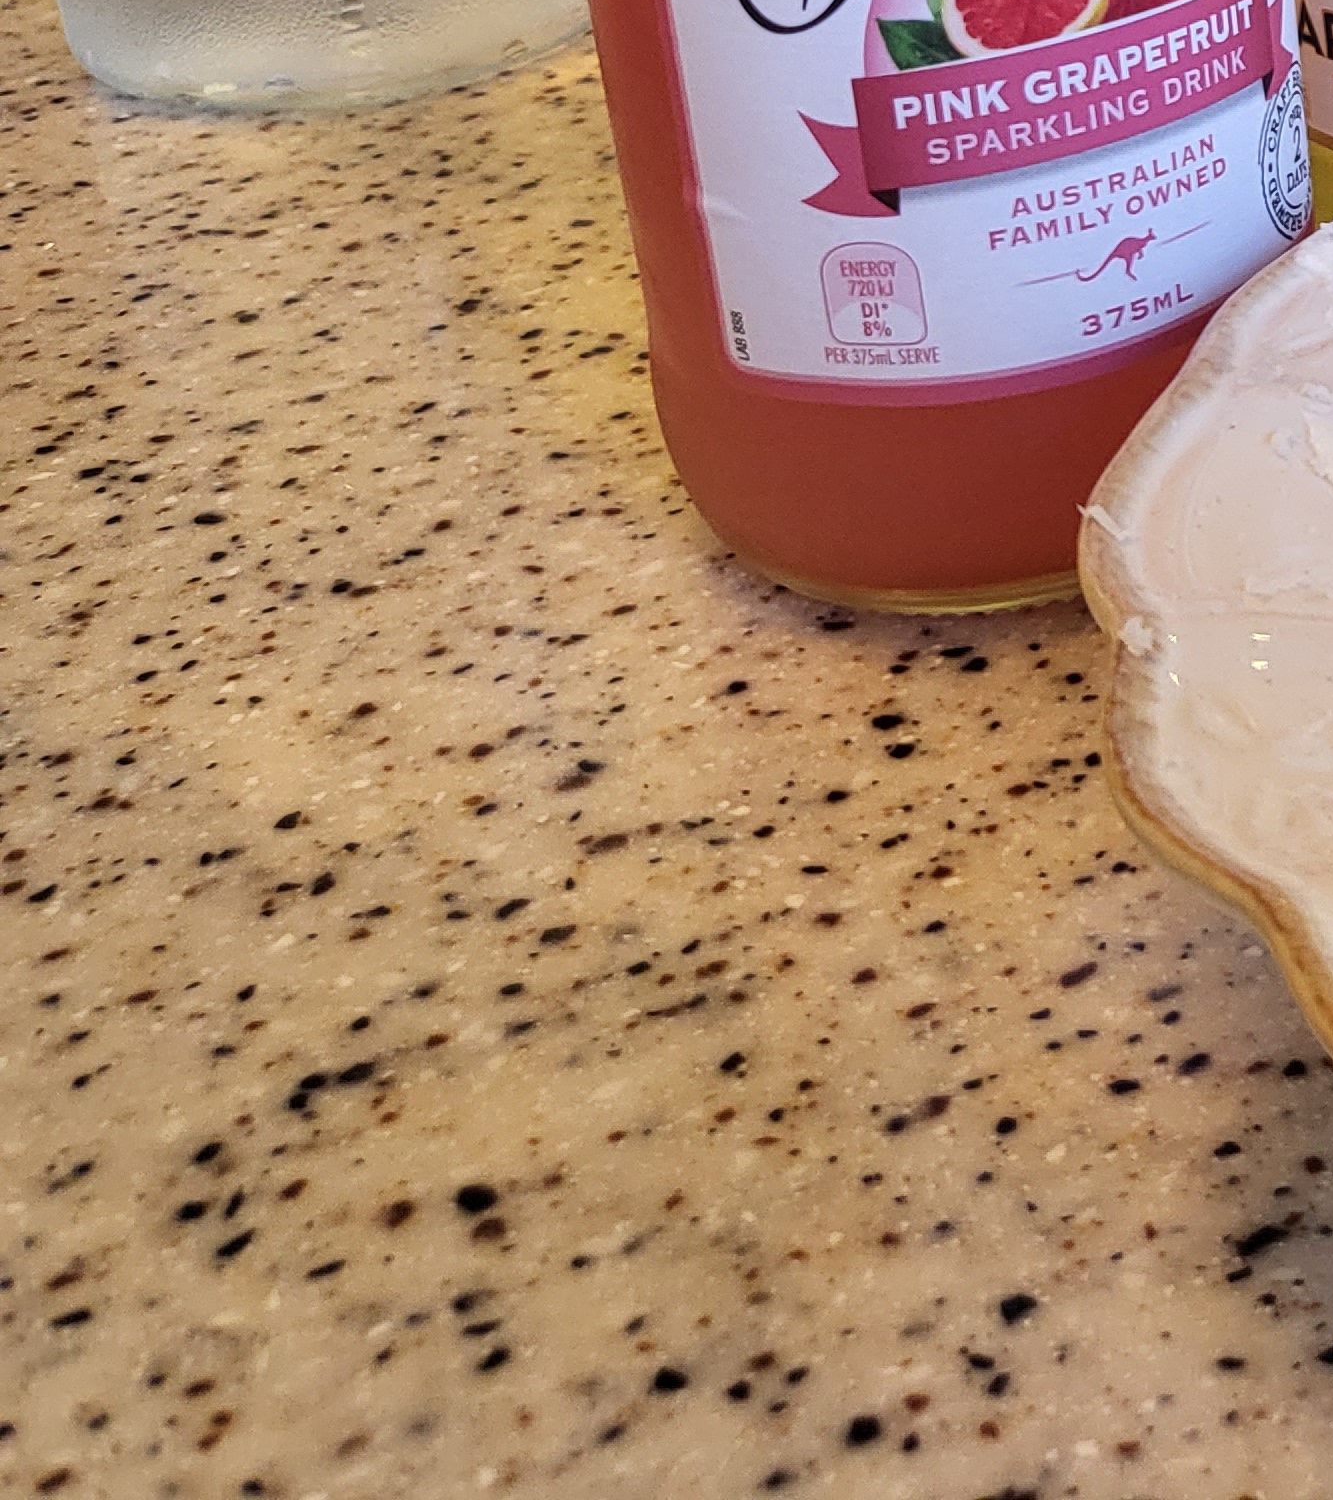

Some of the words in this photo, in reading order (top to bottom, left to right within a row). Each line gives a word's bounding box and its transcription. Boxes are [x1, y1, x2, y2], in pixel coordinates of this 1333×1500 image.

[893, 80, 1010, 130] PINK
[926, 89, 1149, 165] SPARKLING
[1163, 46, 1247, 105] DRINK
[1292, 126, 1301, 164] 2
[1010, 134, 1216, 219] AUSTRALIAN
[988, 203, 1114, 252] FAMILY
[1125, 158, 1228, 215] OWNED
[840, 260, 897, 278] ENERGY
[862, 321, 892, 337] 8%
[1081, 282, 1195, 337] 375ML
[824, 347, 850, 365] PER
[852, 349, 896, 366] 375mL
[898, 346, 941, 366] SERVE
